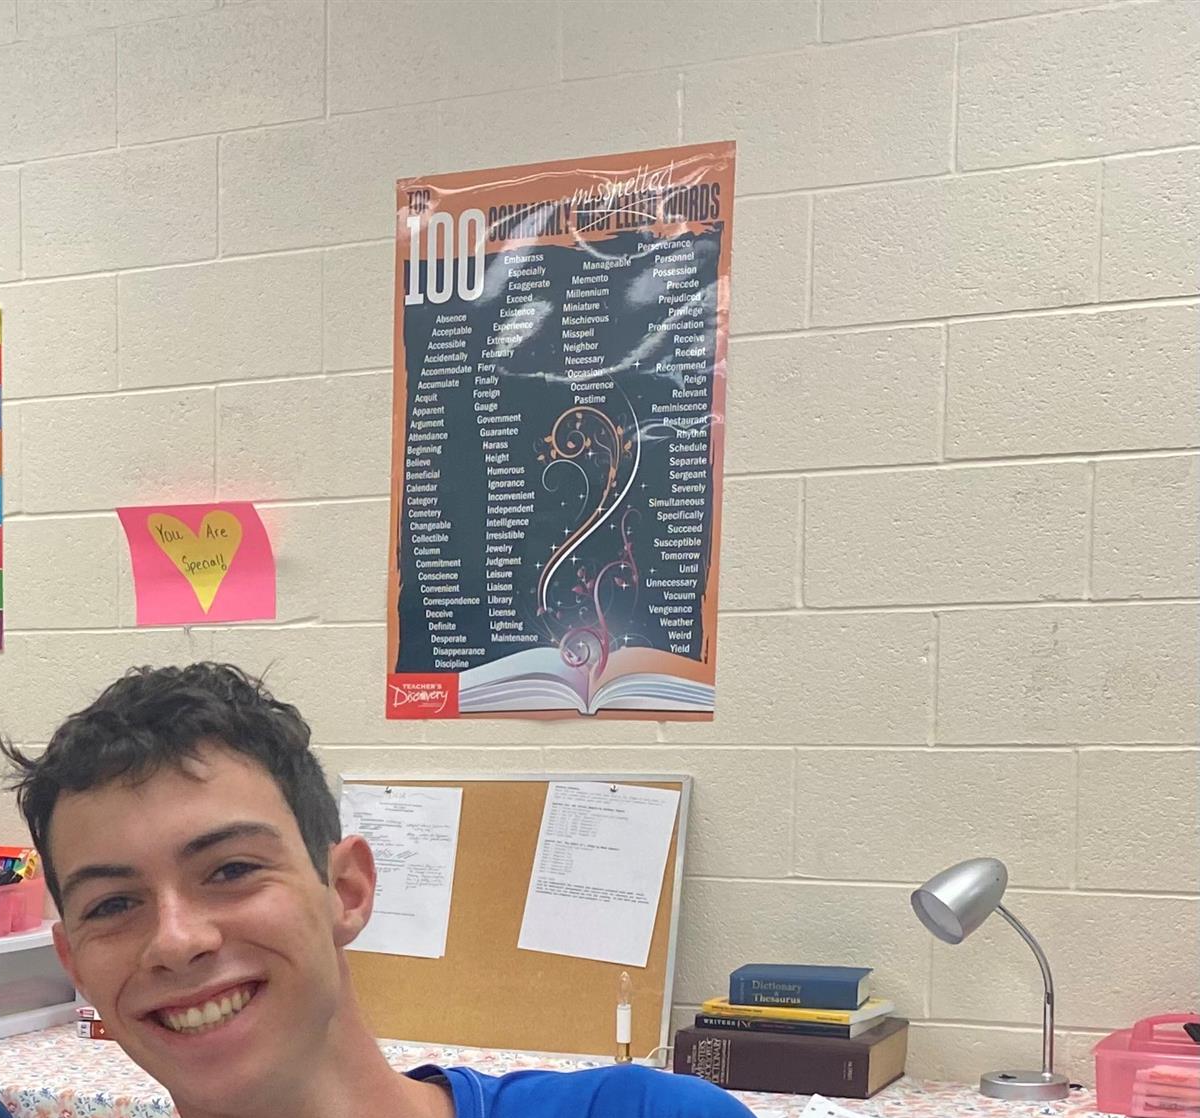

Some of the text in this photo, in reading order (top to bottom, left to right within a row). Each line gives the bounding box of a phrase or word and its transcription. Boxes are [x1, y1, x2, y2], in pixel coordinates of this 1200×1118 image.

[637, 240, 691, 252] Perseverance
[405, 209, 485, 305] 100
[504, 254, 544, 264] Embarrass
[655, 252, 694, 263] Personnel
[583, 258, 631, 271] Manageable
[508, 267, 546, 278] Especially
[653, 266, 697, 278] Possession
[572, 275, 608, 284] Memento
[666, 279, 699, 290] Precede
[509, 280, 550, 291] Exaggerate
[566, 288, 609, 299] Millennium
[507, 294, 533, 304] Exceed
[563, 302, 600, 312] Miniature
[500, 308, 535, 318] Existence
[436, 314, 467, 324] Absence
[562, 314, 609, 325] Mischievous
[432, 326, 472, 337] Acceptable
[493, 321, 534, 332] Experience
[648, 321, 704, 332] Pronunciation
[562, 328, 594, 340] Misspell
[674, 334, 705, 344] Receive
[428, 340, 466, 350] Accessible
[487, 334, 523, 346] Extremely
[564, 341, 599, 353] Neighbor
[675, 347, 706, 357] Receipt
[424, 352, 468, 363] Accidentally
[565, 355, 605, 365] Necessary
[421, 365, 472, 376] Accommodate
[478, 363, 496, 372] Fiery
[656, 361, 706, 372] Recommend
[418, 379, 459, 389] Accumulate
[475, 376, 499, 386] Finally
[684, 375, 707, 385] Reign
[571, 381, 614, 391] Occurrence
[473, 389, 500, 399] Foreign
[672, 388, 707, 398] Relevant
[415, 394, 438, 403] Acquit
[574, 394, 606, 404] Pastime
[413, 406, 445, 416] Apparent
[474, 402, 498, 412] Gauge
[652, 402, 708, 413] Reminiscence
[477, 413, 521, 424] Government
[663, 416, 708, 426] Restaurant
[410, 419, 444, 430] Argument
[408, 431, 448, 442] Attendance
[480, 427, 518, 437] Guarantee
[676, 429, 707, 440] Rhythm
[407, 444, 442, 456] Beginning
[483, 441, 508, 449] Harass
[669, 443, 707, 452] Schedule
[485, 452, 509, 463] Height
[669, 457, 707, 467] Separate
[406, 458, 431, 468] Believe
[406, 470, 440, 480] Beneficial
[487, 466, 525, 475] Humorous
[669, 470, 707, 481] Sergeant
[407, 484, 437, 493] Calendar
[488, 479, 525, 490] Ignorance
[672, 484, 706, 494] Severely
[408, 496, 438, 506] Category
[488, 491, 535, 501] Inconvenient
[649, 498, 705, 508] Simultaneous
[409, 509, 442, 518] Cemetery
[487, 504, 534, 515] Independent
[657, 510, 704, 521] Specifically
[410, 521, 451, 532] Changeable
[487, 518, 529, 528] Intelligence
[155, 524, 228, 544] You Are
[667, 525, 702, 534] Succeed
[412, 534, 449, 543] Collectible
[486, 531, 525, 540] Irresistible
[654, 538, 701, 548] Susceptible
[414, 547, 440, 556] Column
[485, 544, 513, 554] Jewelry
[661, 552, 700, 560] Tomorrow
[181, 554, 227, 575] Special!
[416, 559, 461, 568] Commitment
[485, 557, 522, 567] Judgment
[679, 564, 698, 573] Until
[418, 572, 458, 580] Conscience
[487, 569, 513, 579] Leisure
[421, 584, 460, 593] Convenient
[487, 582, 513, 591] Liaison
[646, 578, 697, 589] Unnecessary
[488, 596, 513, 605] Library
[664, 591, 696, 600] Vacuum
[423, 597, 480, 606] Correspondence
[426, 610, 453, 618] Deceive
[489, 608, 516, 617] License
[649, 605, 692, 615] Vengeance
[429, 622, 456, 630] Definite
[490, 621, 523, 631] Lightning
[660, 618, 693, 626] Weather
[431, 635, 467, 644] Desperate
[491, 633, 538, 642] Maintenance
[668, 631, 692, 639] Weird
[433, 647, 485, 657] Disappearance
[670, 644, 689, 653] Yield
[435, 659, 469, 669] Discipline
[752, 980, 801, 992] Dictionary
[753, 993, 800, 1004] Thesaurus
